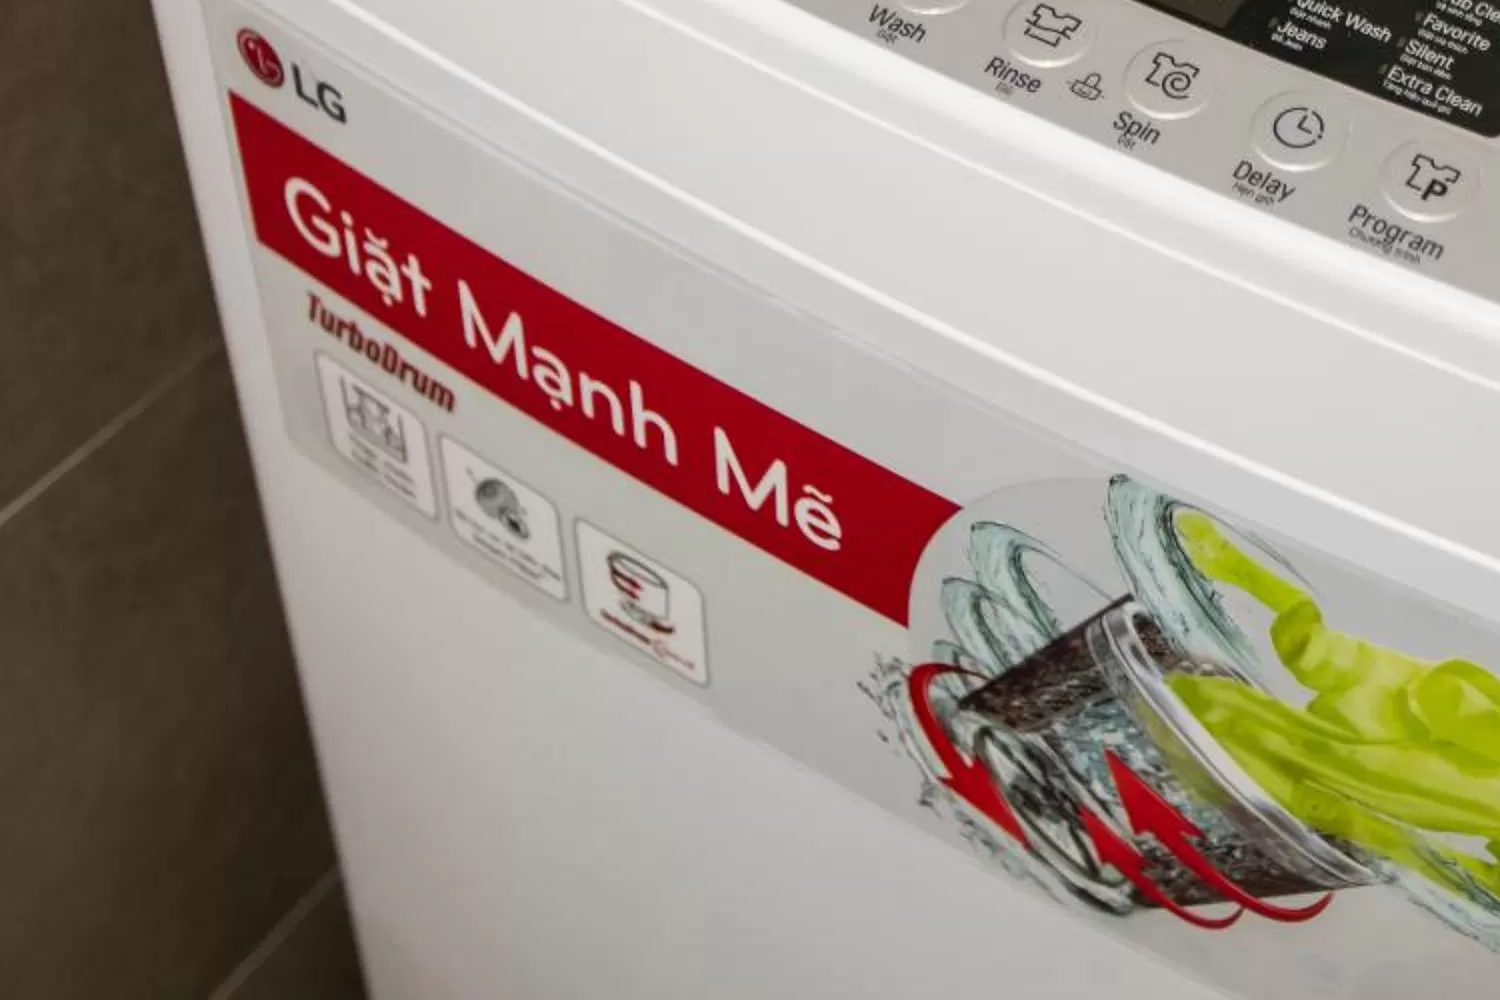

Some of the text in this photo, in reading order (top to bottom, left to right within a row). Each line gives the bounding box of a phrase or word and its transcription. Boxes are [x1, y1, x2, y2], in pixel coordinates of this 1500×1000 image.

[868, 3, 927, 44] Wash
[1277, 21, 1328, 49] Jeans
[1345, 11, 1392, 43] Wash
[1423, 12, 1491, 51] Favorite
[984, 56, 1042, 93] Rinse
[1405, 38, 1455, 70] Silent
[291, 61, 347, 124] LG
[1387, 64, 1434, 95] Extra
[1435, 84, 1483, 117] Clean
[1112, 110, 1162, 144] Spin
[1231, 159, 1297, 203] Delay
[1347, 204, 1446, 261] Program
[284, 177, 433, 318] Giặt
[457, 279, 679, 467] Mạnh
[712, 426, 843, 552] Mẽ
[307, 292, 457, 414] TurboDrum
